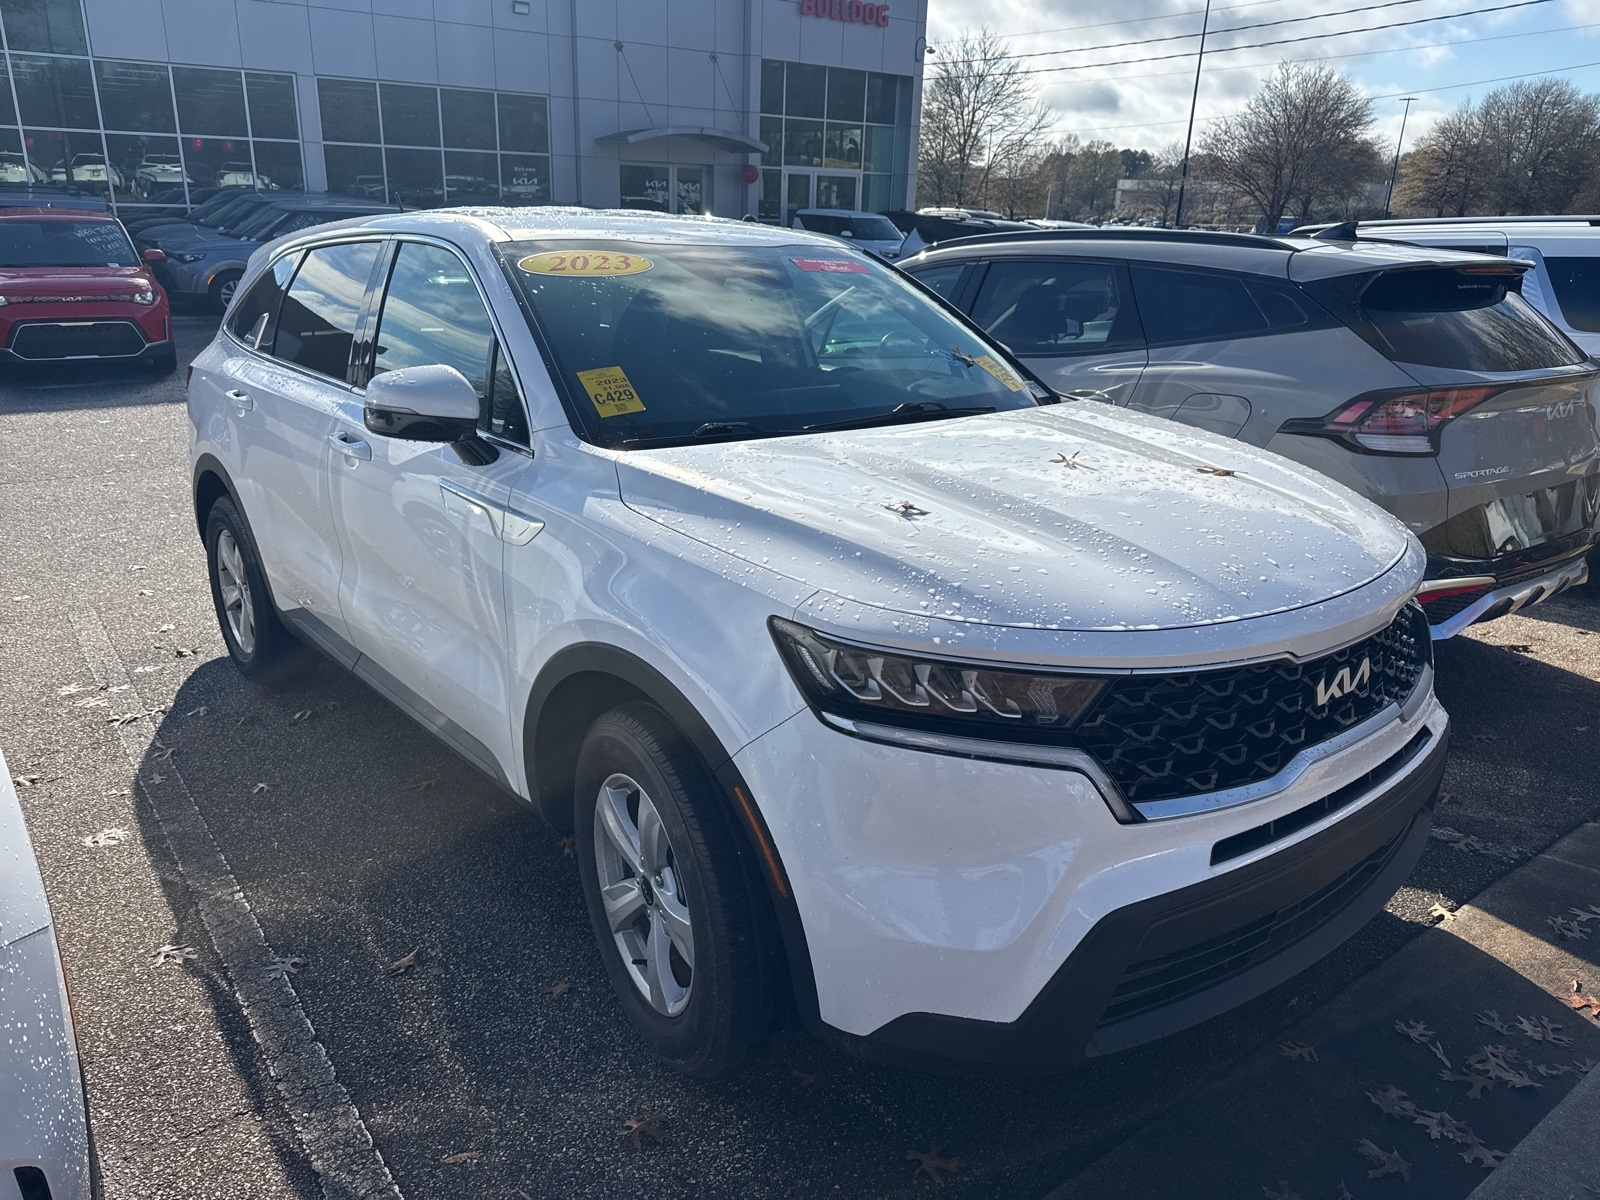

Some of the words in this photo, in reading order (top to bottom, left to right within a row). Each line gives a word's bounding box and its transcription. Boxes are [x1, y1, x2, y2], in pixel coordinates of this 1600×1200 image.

[800, 0, 890, 27] BULLDOG
[549, 255, 631, 272] 2023
[595, 376, 627, 386] 2023
[593, 388, 635, 405] C429
[1546, 400, 1575, 421] KIA
[1454, 465, 1510, 480] SPORTAGE
[1316, 656, 1371, 706] KIA
